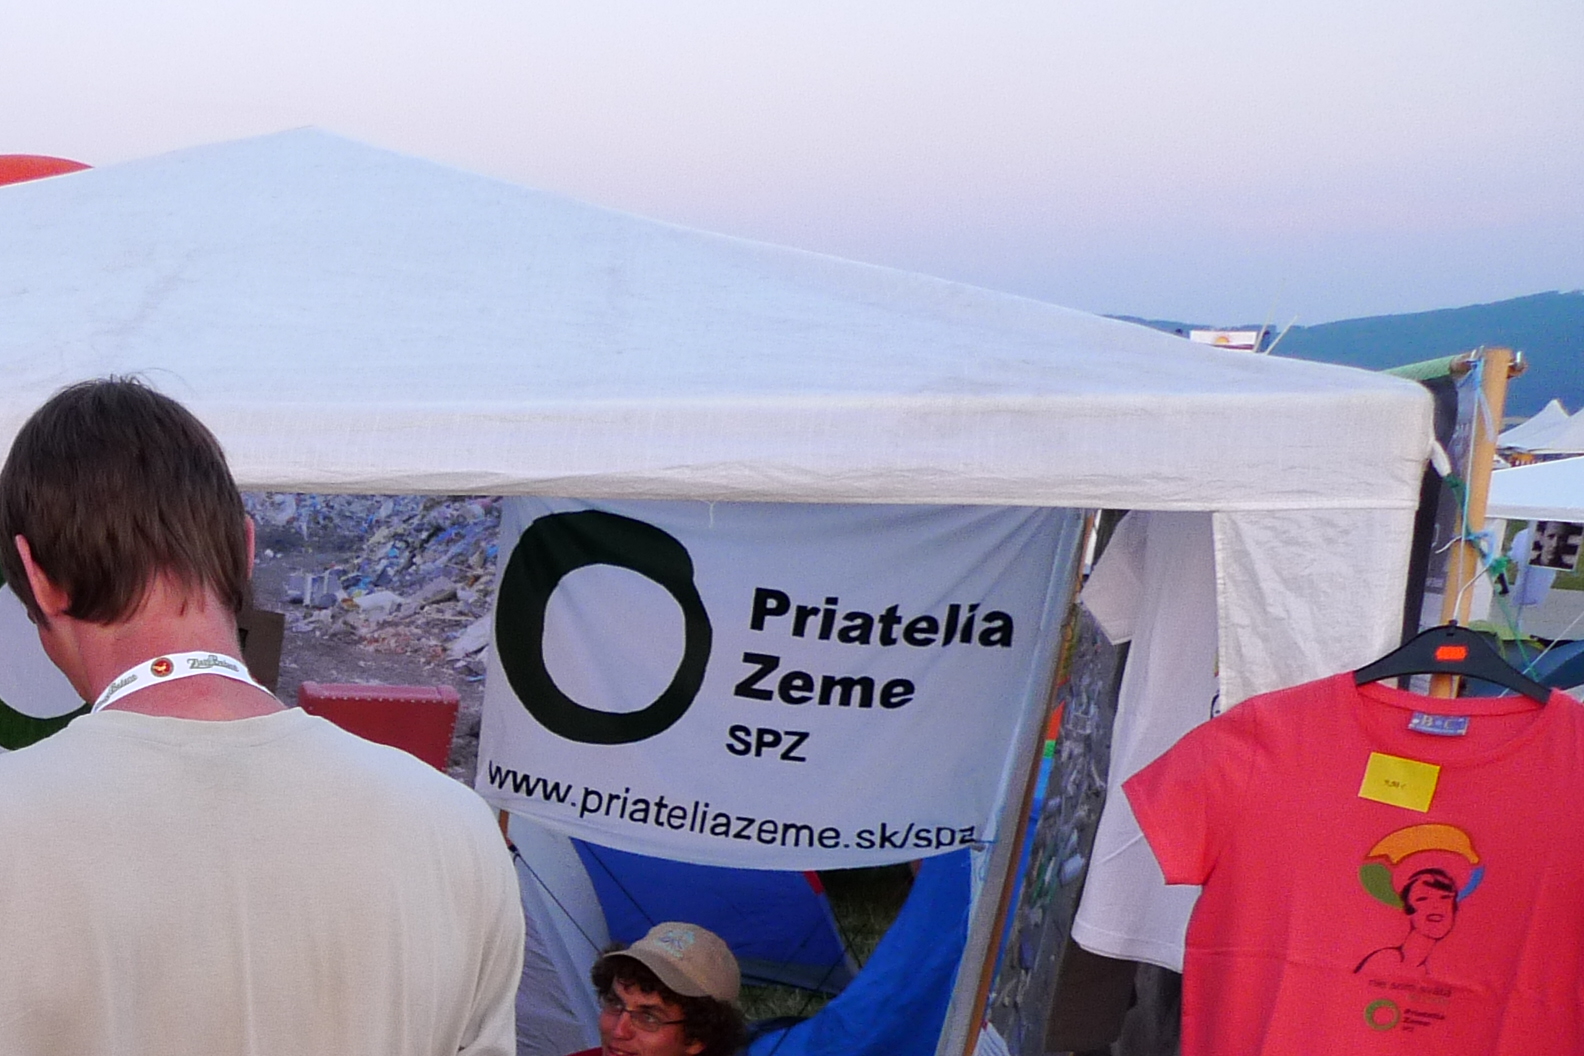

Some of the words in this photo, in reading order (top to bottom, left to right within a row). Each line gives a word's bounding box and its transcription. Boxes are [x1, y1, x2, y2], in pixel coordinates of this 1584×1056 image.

[749, 586, 1014, 648] Priatelia
[733, 651, 915, 709] Zeme
[725, 725, 811, 762] SPZ
[488, 758, 976, 850] www.priateliazeme.sk/spz
